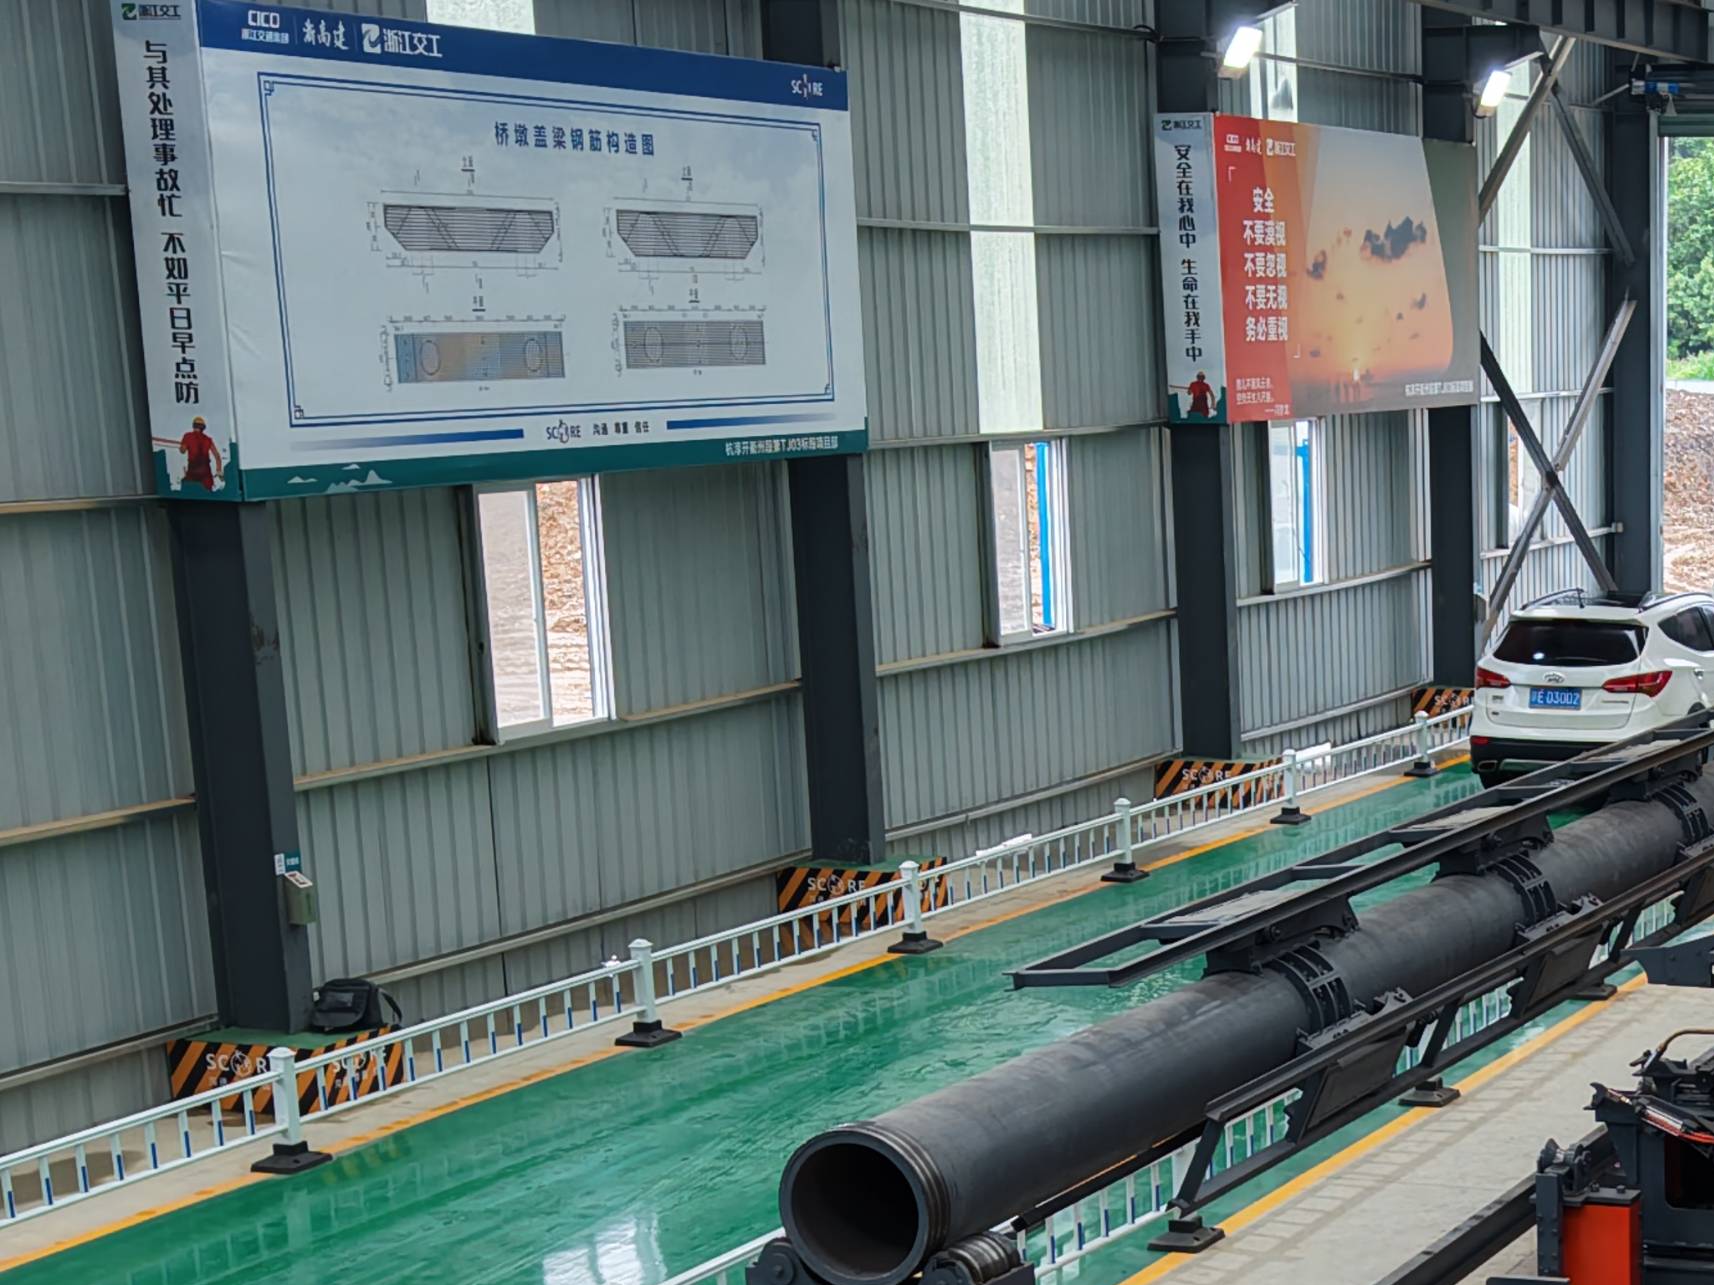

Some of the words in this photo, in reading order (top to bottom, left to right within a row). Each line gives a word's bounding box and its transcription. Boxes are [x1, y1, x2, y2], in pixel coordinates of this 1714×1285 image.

[383, 28, 443, 57] 浙江交工
[143, 40, 183, 218] 与其处理事故忙
[494, 121, 655, 156] 桥墩盖梁钢筋构造图
[1174, 144, 1196, 249] 安全在我心中
[1252, 187, 1275, 213] 安全
[1180, 258, 1202, 362] 生命在我手中
[1245, 284, 1288, 311] 不要无视
[161, 232, 200, 404] 不如平日早点防
[1245, 316, 1289, 342] 务必重视
